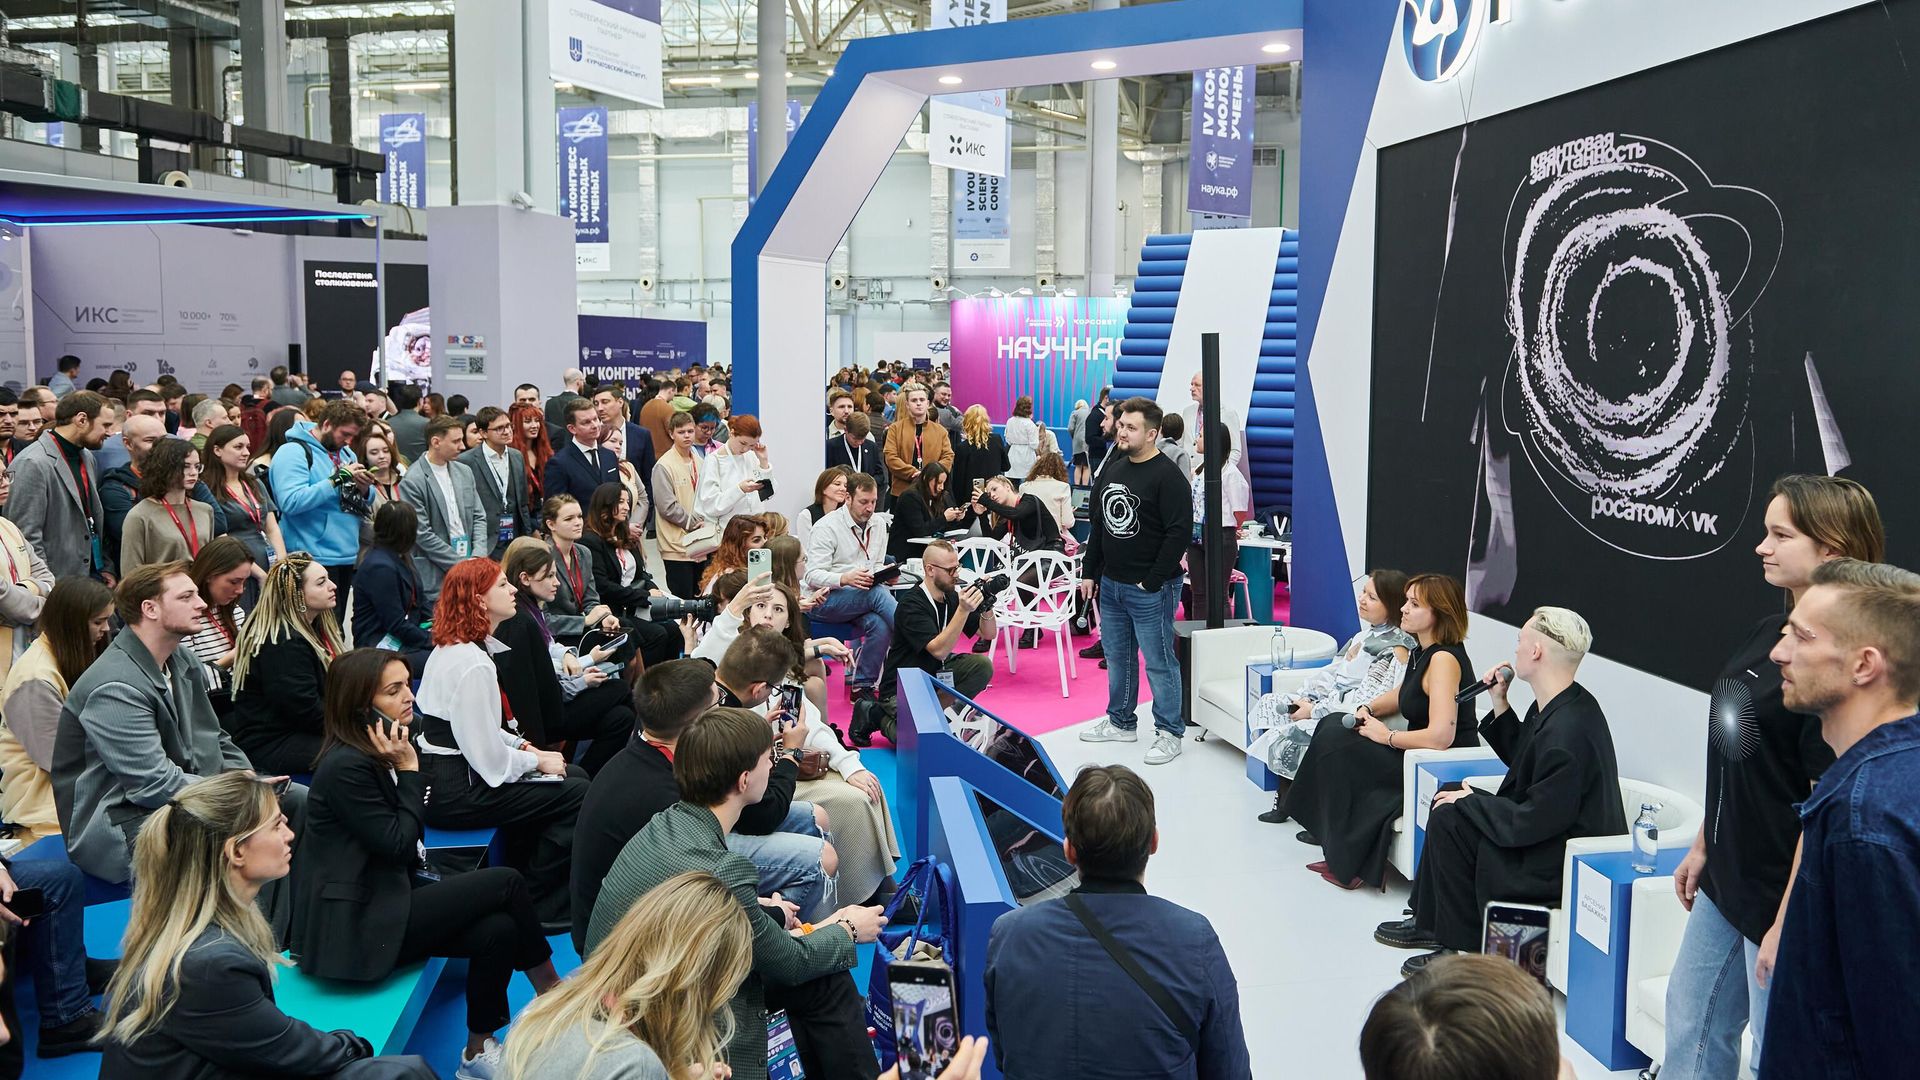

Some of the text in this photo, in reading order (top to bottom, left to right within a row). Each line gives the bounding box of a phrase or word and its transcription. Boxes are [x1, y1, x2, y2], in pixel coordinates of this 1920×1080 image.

[1202, 112, 1215, 136] IV
[965, 141, 986, 157] ИКС
[568, 146, 578, 209] КОНГРЕСС
[580, 157, 589, 223] МОЛОДЫХ
[591, 170, 600, 223] УЧЕНЫХ
[990, 175, 999, 211] CONG
[1201, 183, 1239, 199] наука.рф
[967, 199, 976, 211] IV
[575, 227, 600, 238] ука.рф
[314, 269, 374, 280] Последствия
[314, 279, 379, 288] столкновений
[75, 306, 119, 324] ИКС
[448, 335, 474, 344] BRCS
